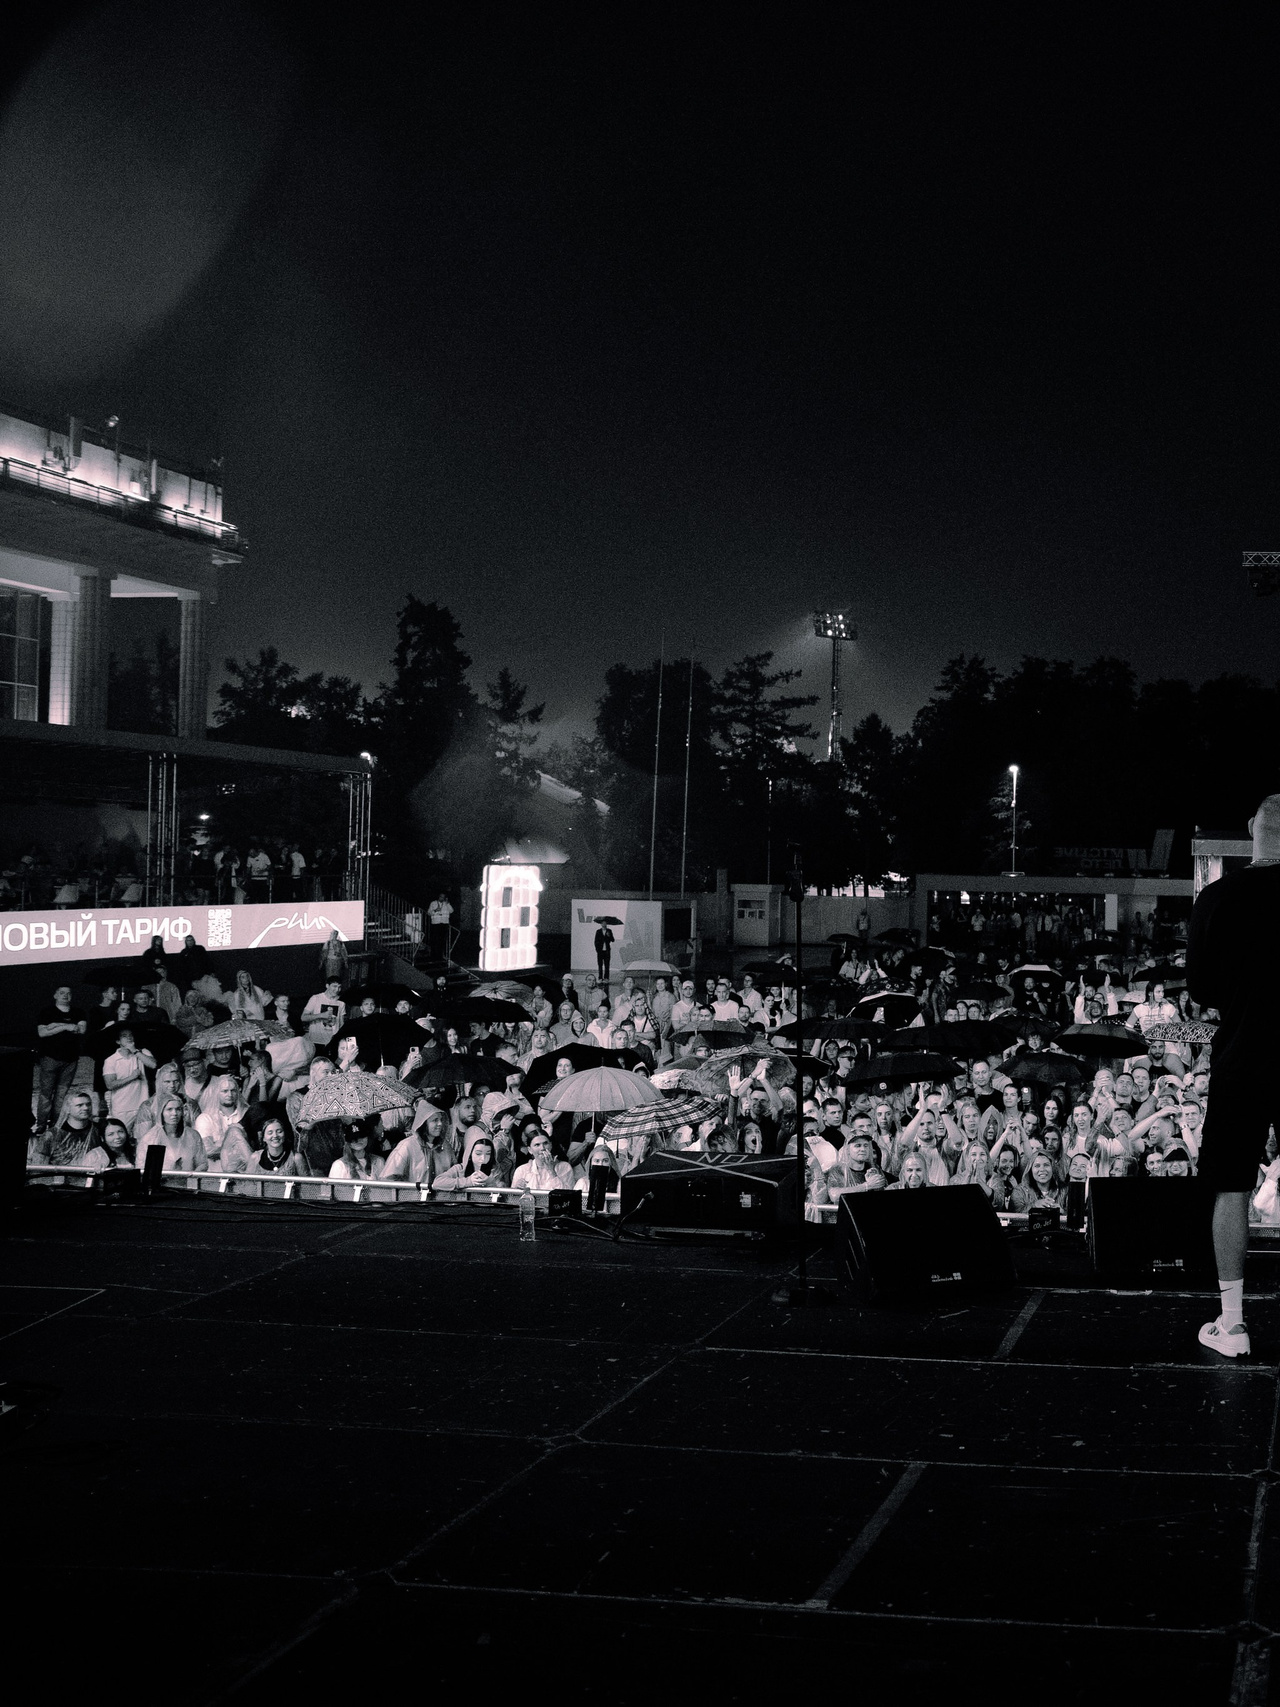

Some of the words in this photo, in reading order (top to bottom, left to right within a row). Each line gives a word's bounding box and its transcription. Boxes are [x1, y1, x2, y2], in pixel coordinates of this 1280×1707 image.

[0, 912, 97, 952] ОВЫЙ
[102, 916, 192, 946] ТАРИФ
[696, 1152, 748, 1164] NO
